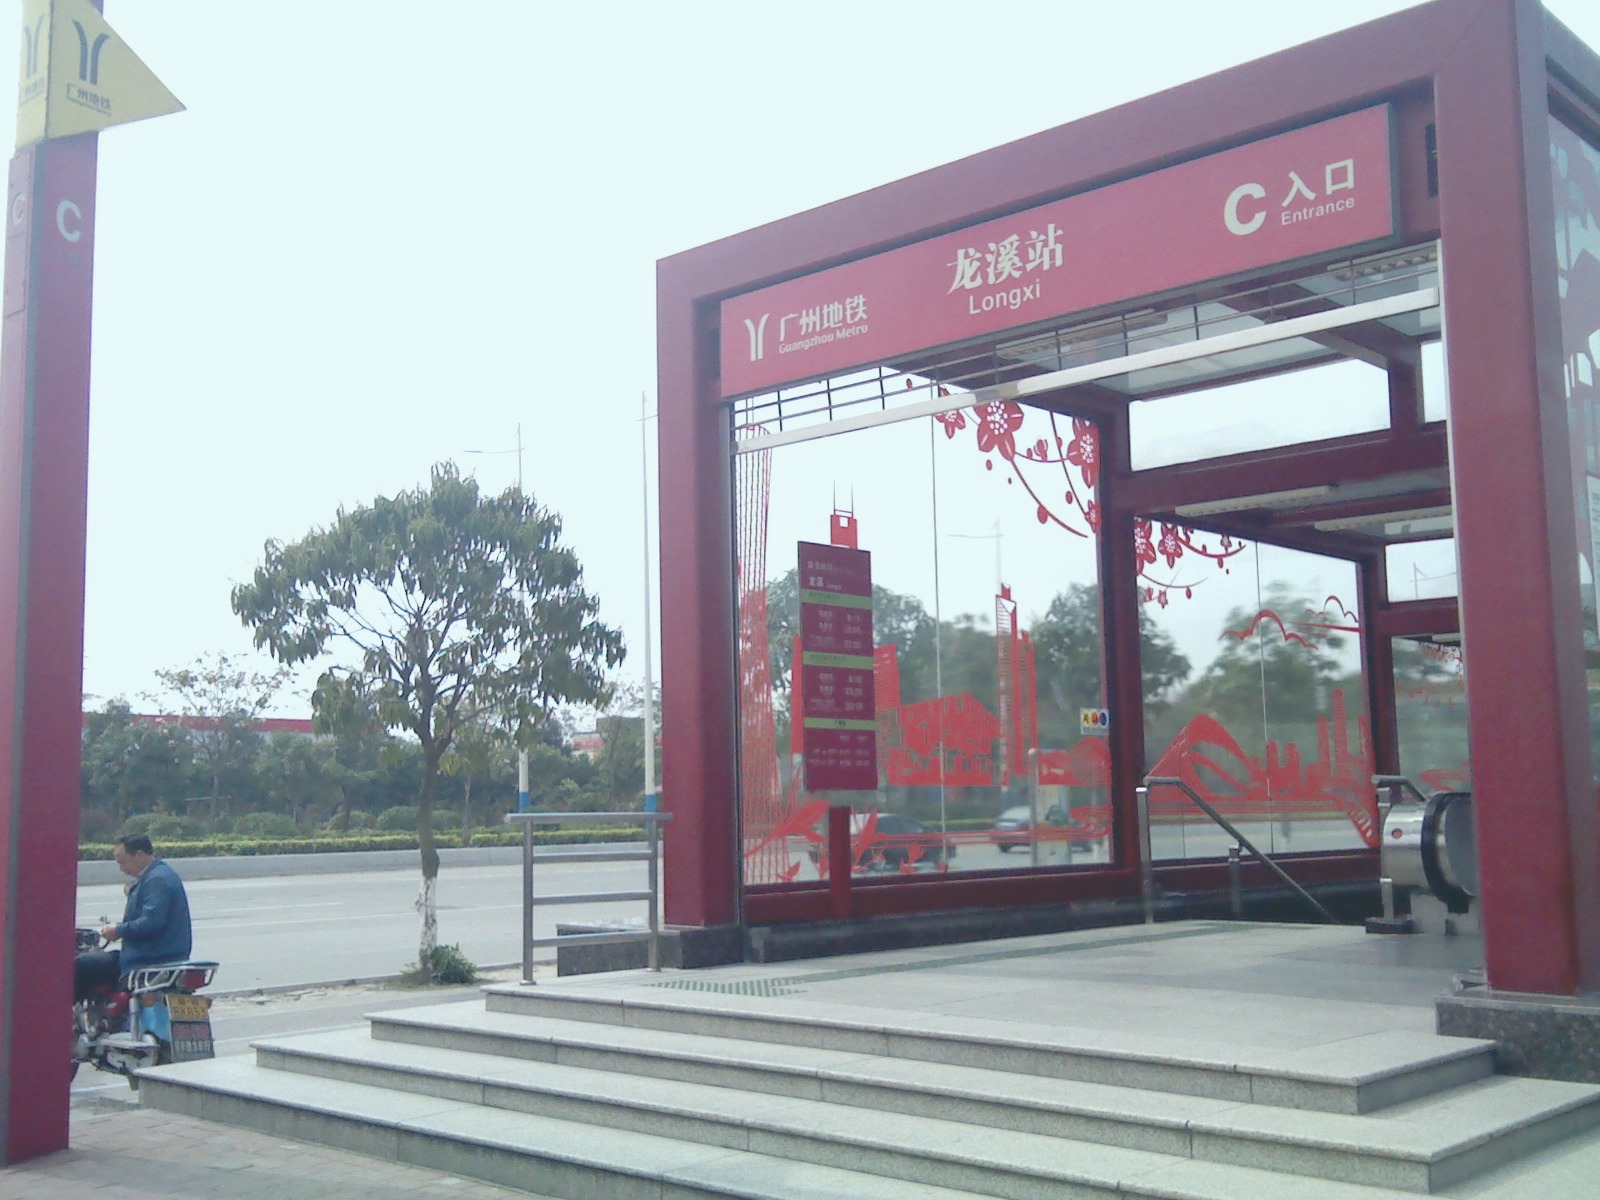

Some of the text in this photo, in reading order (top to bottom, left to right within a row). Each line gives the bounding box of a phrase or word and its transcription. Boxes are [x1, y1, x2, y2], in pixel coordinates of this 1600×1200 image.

[1223, 158, 1355, 236] C 入口
[1281, 197, 1355, 226] Entrance
[56, 199, 82, 242] C
[946, 223, 1064, 295] 龙溪站
[779, 294, 868, 342] 广州地铁
[969, 278, 1040, 315] Longxi
[779, 324, 868, 354] Guangzhou Metro
